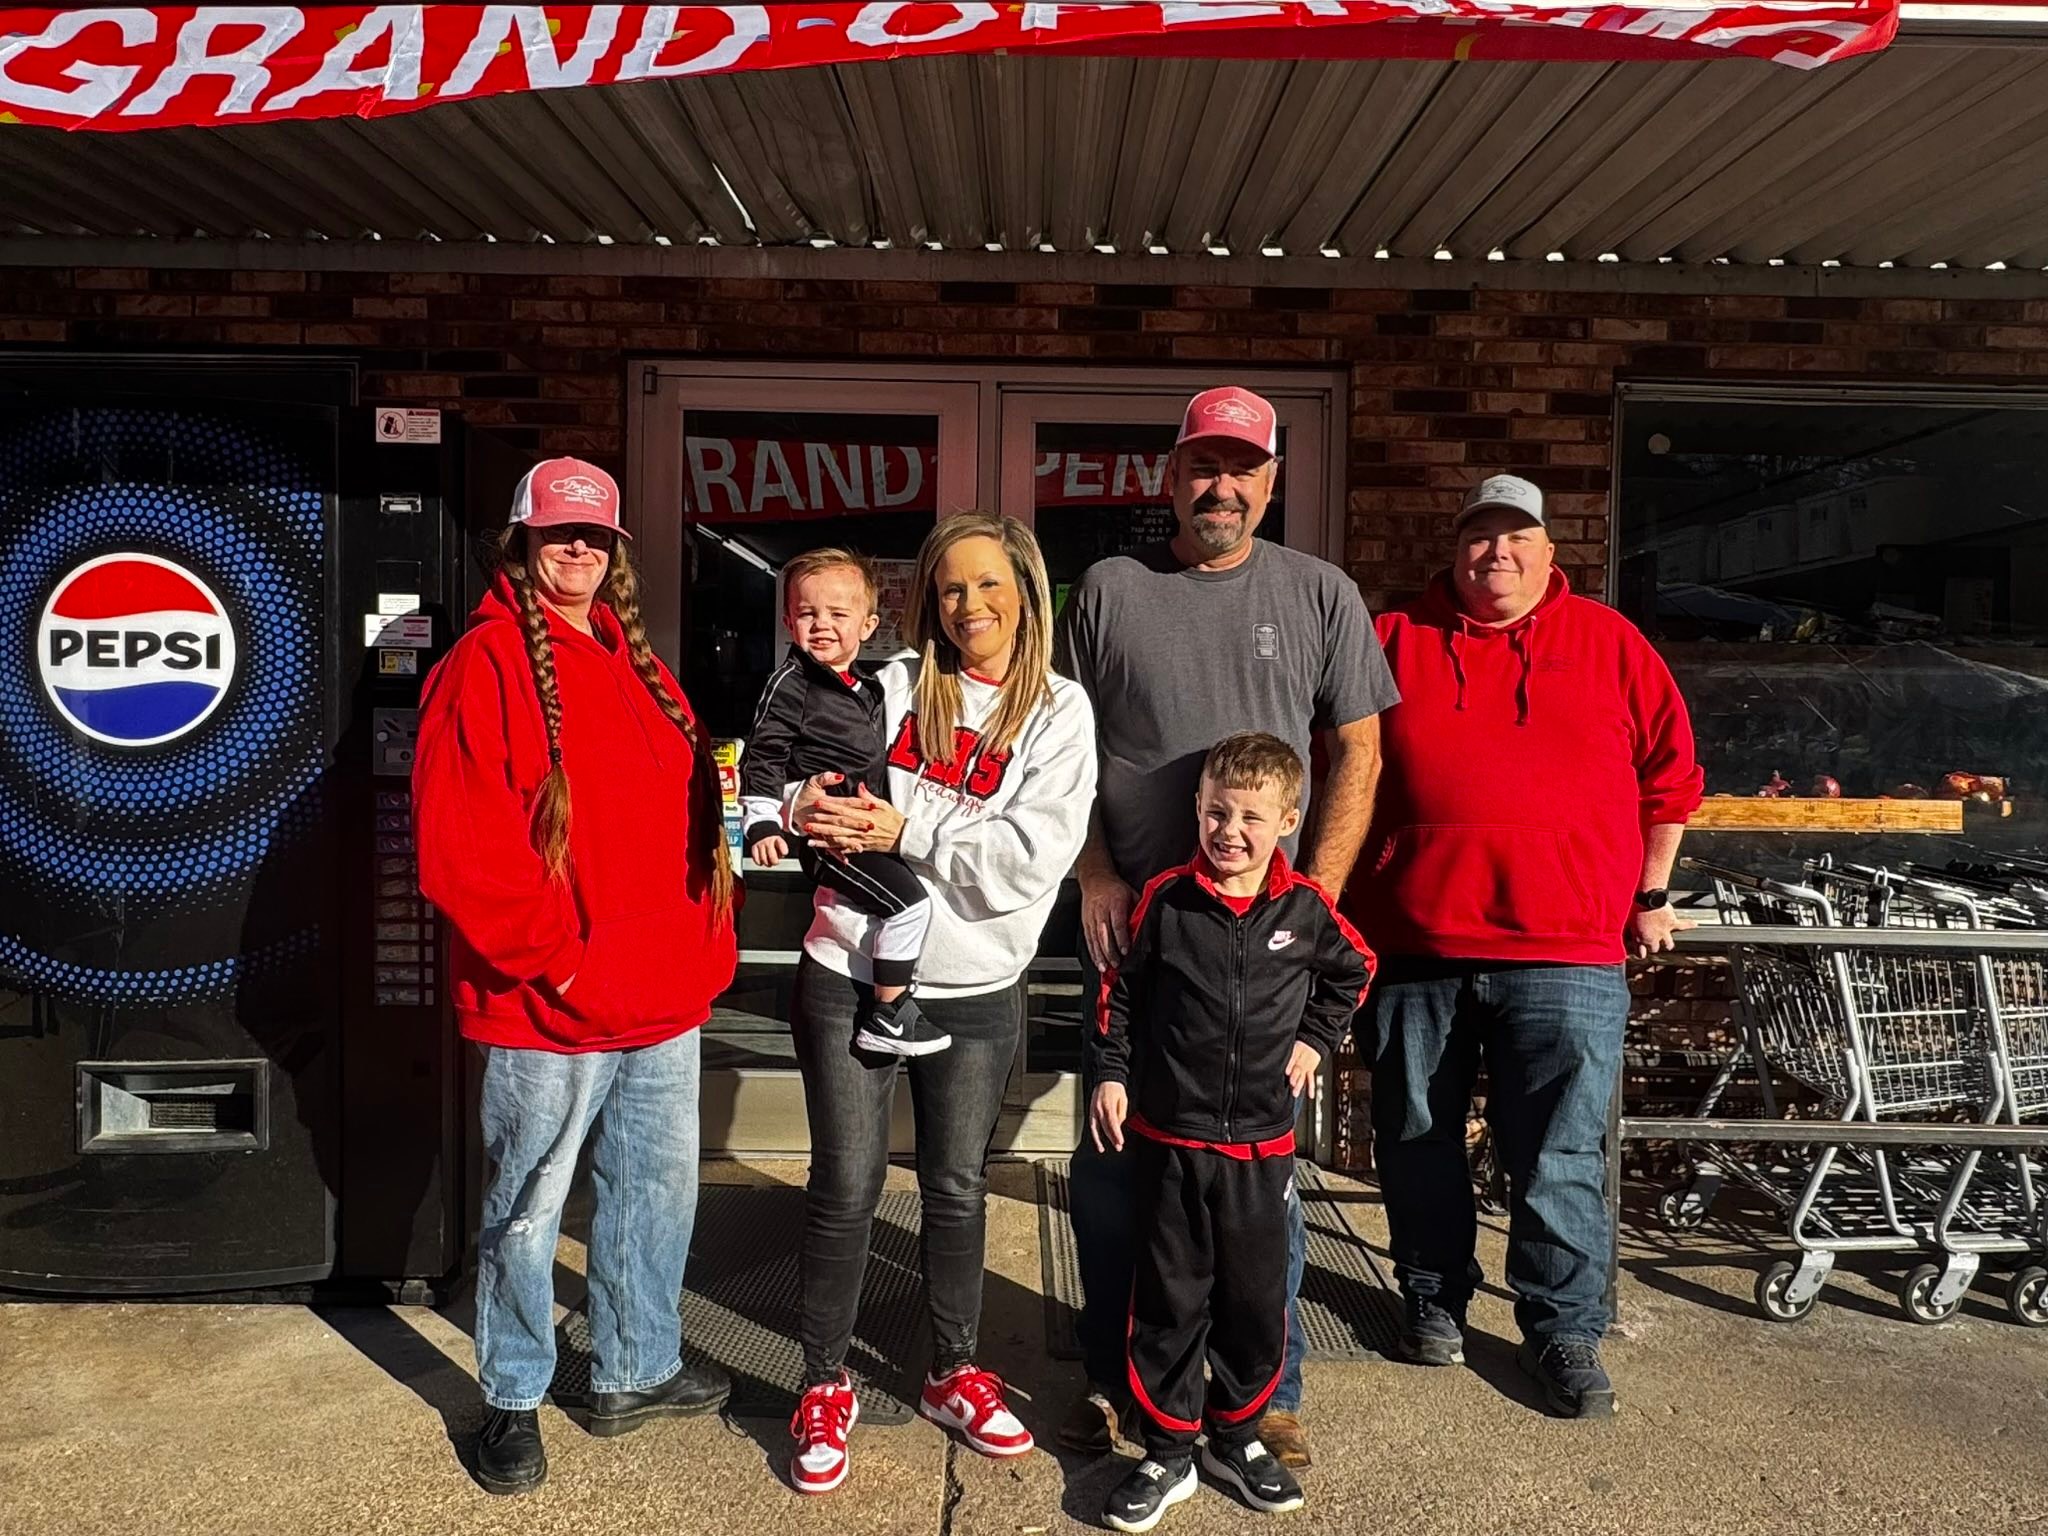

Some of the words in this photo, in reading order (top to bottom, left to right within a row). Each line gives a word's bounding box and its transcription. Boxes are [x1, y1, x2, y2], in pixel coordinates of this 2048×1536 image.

[0, 4, 771, 118] GRAND
[683, 435, 925, 513] RAND
[50, 629, 221, 670] PEPSI
